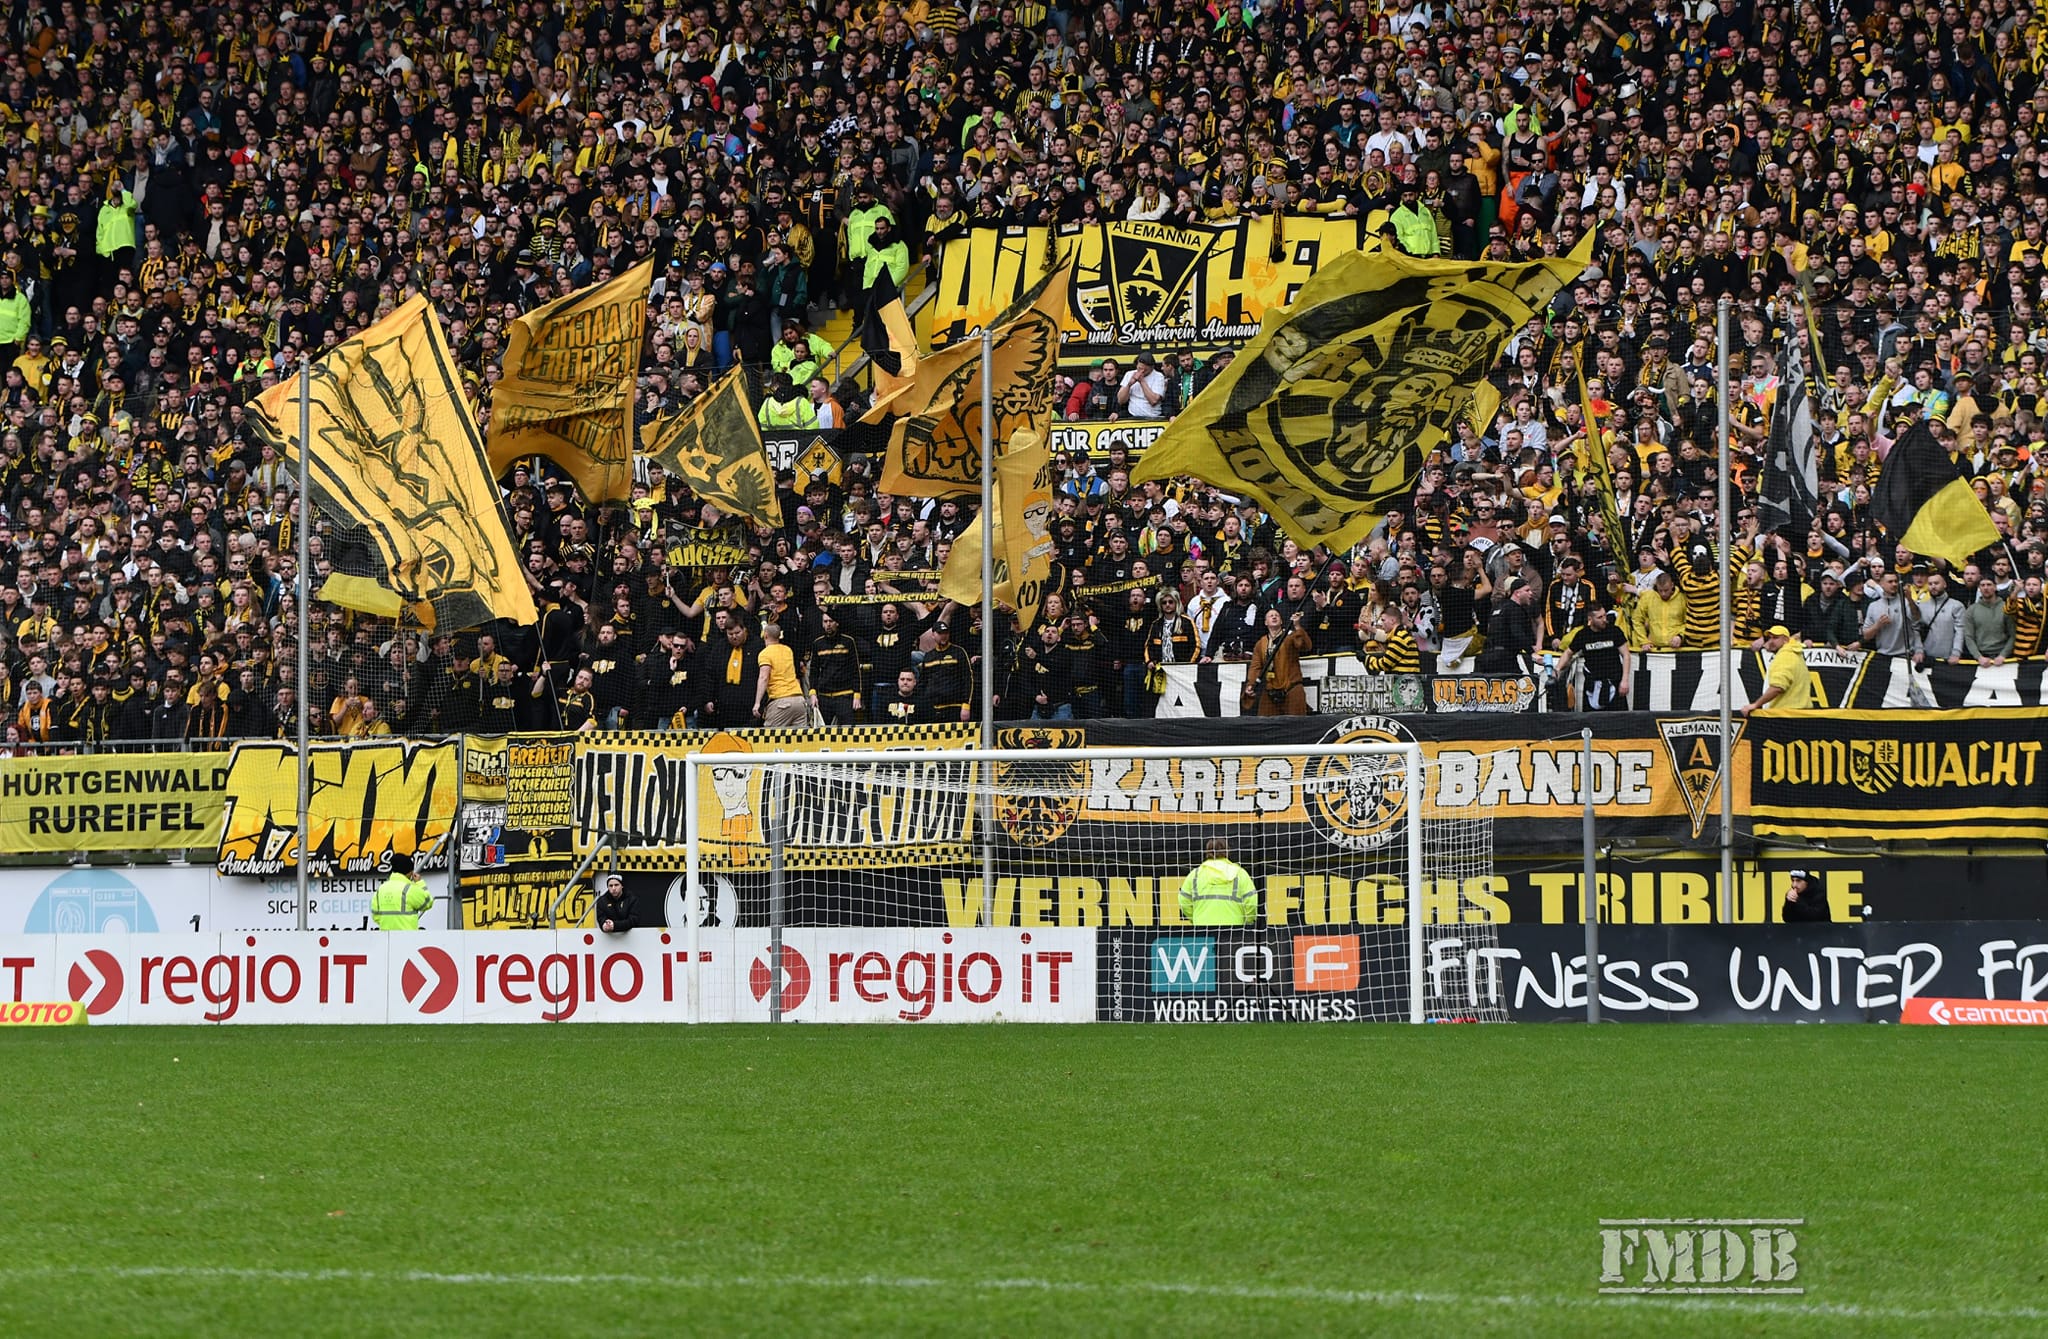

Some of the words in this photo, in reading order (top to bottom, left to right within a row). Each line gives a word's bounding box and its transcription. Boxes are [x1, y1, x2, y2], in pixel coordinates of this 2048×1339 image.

[1113, 221, 1201, 247] ALEMANNIA
[1132, 247, 1164, 281] A
[1088, 327, 1113, 344] und
[1201, 318, 1262, 341] Alemann
[1051, 427, 1090, 451] FÜR
[668, 543, 746, 567] AACHEN
[823, 594, 862, 605] YELLOW
[874, 591, 938, 603] CONNECTION
[1321, 676, 1393, 692] LEGENDEN
[1432, 678, 1518, 705] ULTRAS
[1321, 692, 1370, 708] STERBEN
[1335, 716, 1401, 737] KARLS
[509, 745, 572, 766] FREIHEIT
[1689, 737, 1713, 766] A
[1761, 739, 1849, 785] DOM
[1902, 740, 2043, 788] WACHT
[2, 765, 227, 798] HÜRTGENWALD
[508, 778, 571, 792] SICHERHEIT
[1087, 757, 1293, 812] KARLS
[1435, 749, 1654, 806] BANDE
[507, 791, 521, 803] ZU
[539, 802, 571, 814] BEIDES
[28, 801, 205, 835] RUREIFEL
[467, 807, 506, 827] NEIN
[507, 815, 520, 827] ZU
[1329, 830, 1394, 848] BANDE
[217, 850, 285, 874] Aachener
[347, 852, 373, 873] und
[461, 844, 482, 863] ZU
[485, 844, 506, 865] RB
[267, 879, 318, 894] SICHR
[321, 879, 386, 894] BESTELL
[267, 900, 318, 914] SICHR
[475, 883, 586, 926] HALTUNG
[941, 876, 1194, 926] WERNE
[1266, 874, 1511, 925] FUCHS
[140, 935, 300, 1022] regio
[318, 935, 368, 1005] iT
[475, 933, 644, 1022] regio
[829, 932, 1003, 1022] regio
[1021, 931, 1073, 1004] iT
[1427, 939, 1699, 1012] FITNESS
[0, 1003, 73, 1023] LOTTO
[1153, 999, 1228, 1021] WORLD
[1235, 999, 1262, 1021] OF
[1268, 998, 1357, 1021] FITNESS
